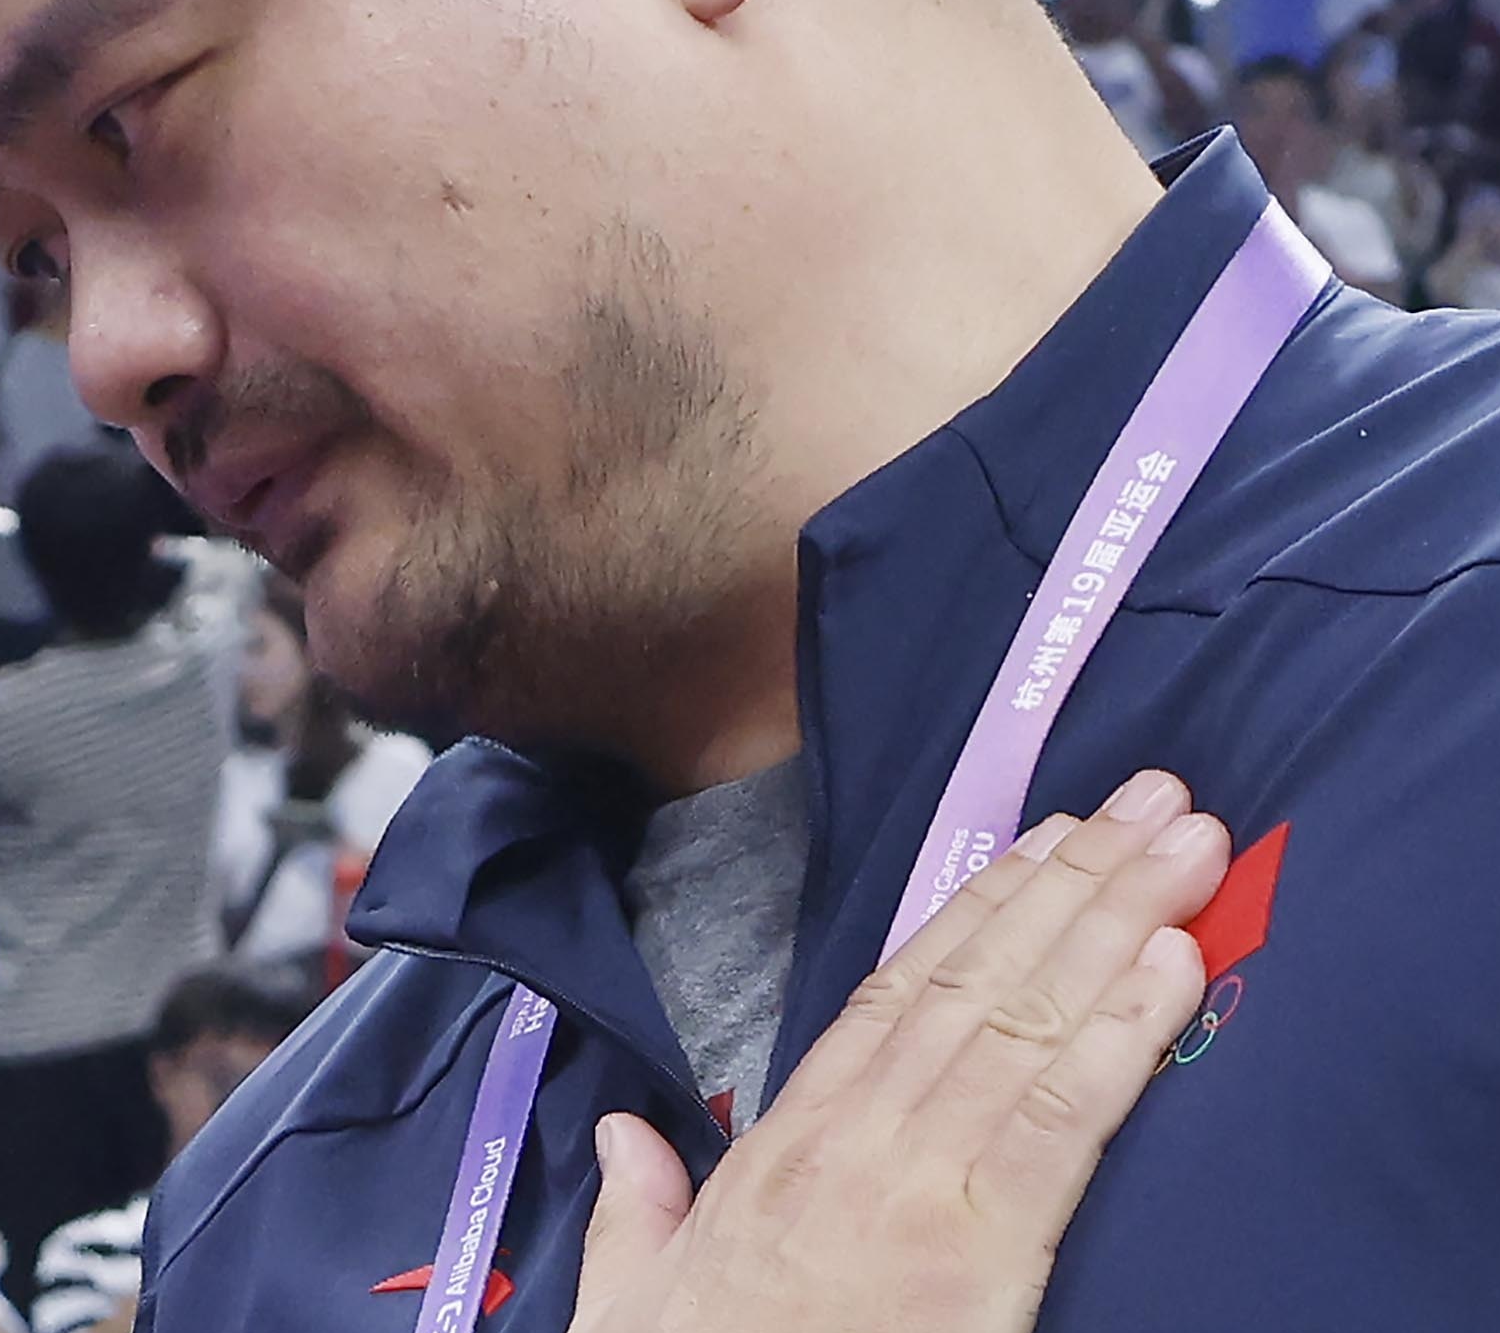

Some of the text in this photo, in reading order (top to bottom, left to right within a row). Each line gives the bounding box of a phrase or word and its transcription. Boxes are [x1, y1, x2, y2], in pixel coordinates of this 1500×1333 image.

[1011, 450, 1177, 710] 杭州第19届亚运会
[933, 828, 969, 892] Games
[446, 1136, 507, 1295] Alibaba Cloud
